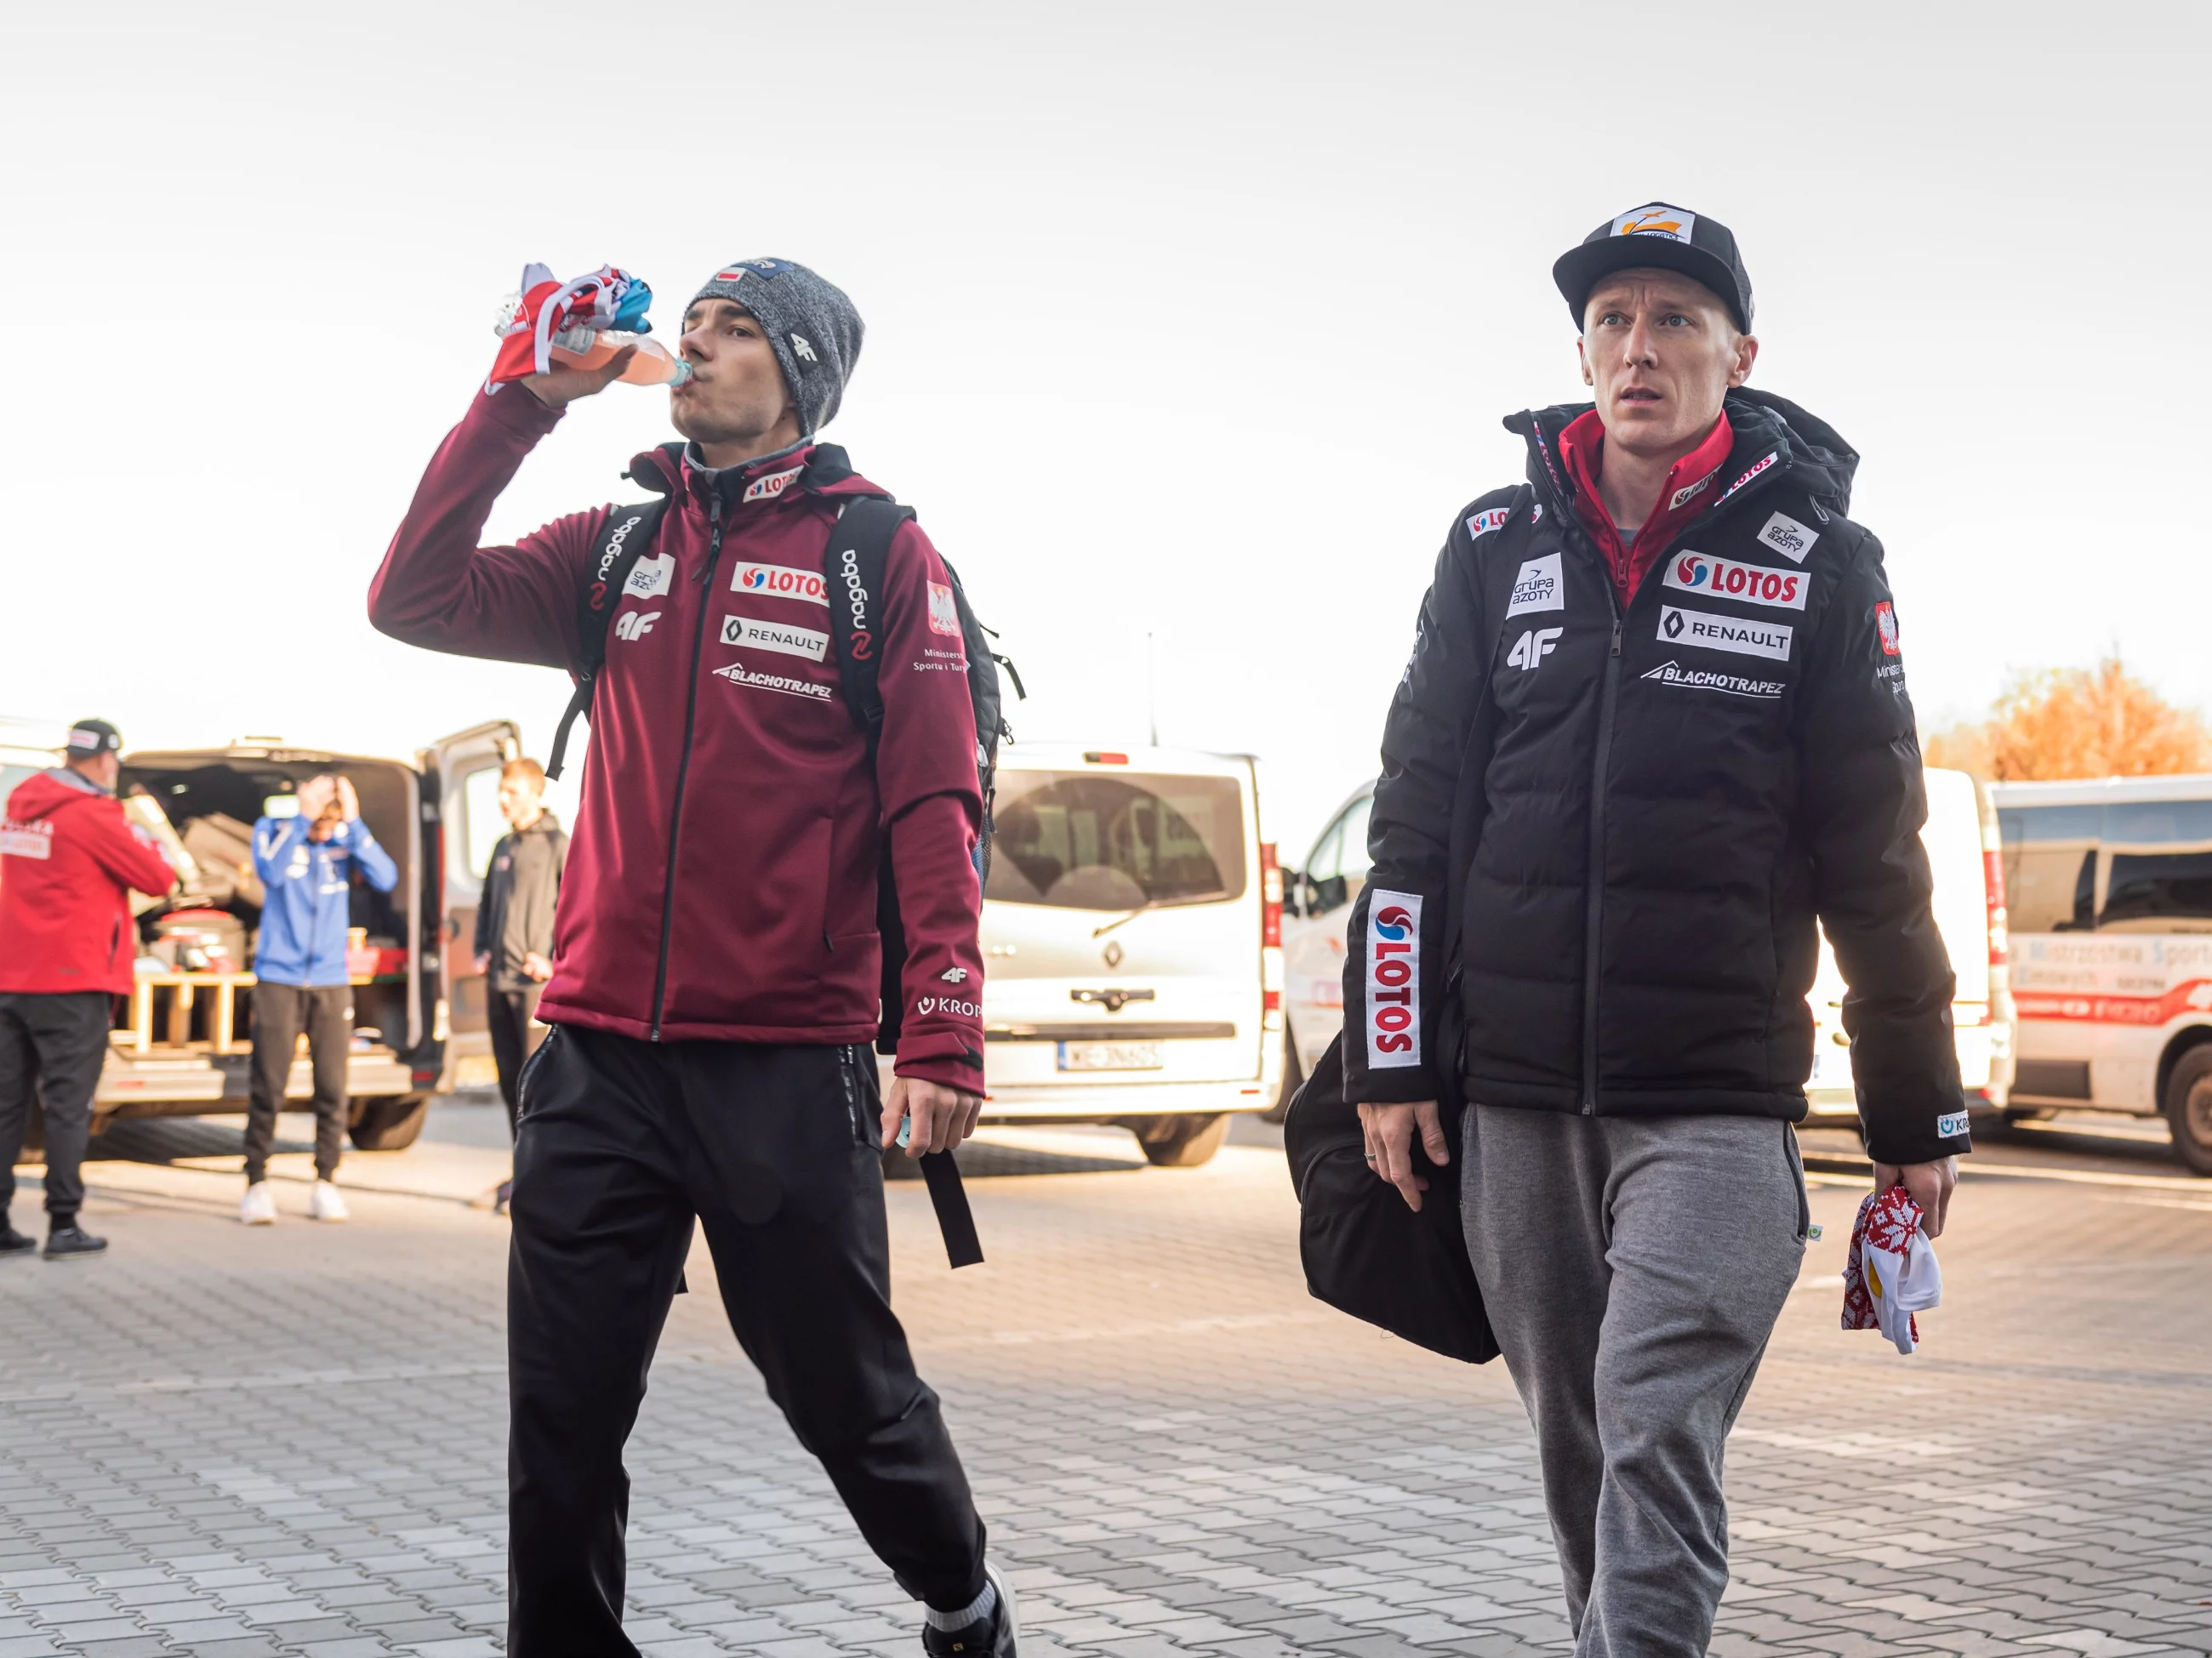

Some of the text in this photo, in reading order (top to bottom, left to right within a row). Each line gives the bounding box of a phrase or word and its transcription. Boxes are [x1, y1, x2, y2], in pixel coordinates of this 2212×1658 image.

[790, 333, 818, 362] 4F
[1730, 456, 1772, 491] LOTOS
[597, 516, 642, 582] nagaba
[841, 549, 869, 630] nagaba
[1710, 562, 1799, 602] LOTOS
[615, 611, 662, 641] 4F
[749, 628, 824, 652] RENAULT
[1691, 622, 1788, 649] RENAULT
[1507, 626, 1564, 671] 4F
[913, 662, 944, 672] Sportu
[1663, 667, 1786, 694] BLACHOTRAPEZ
[729, 669, 833, 698] BLACHOTRAPEZ
[941, 967, 967, 983] 4F
[1375, 943, 1412, 1053] LOTOS
